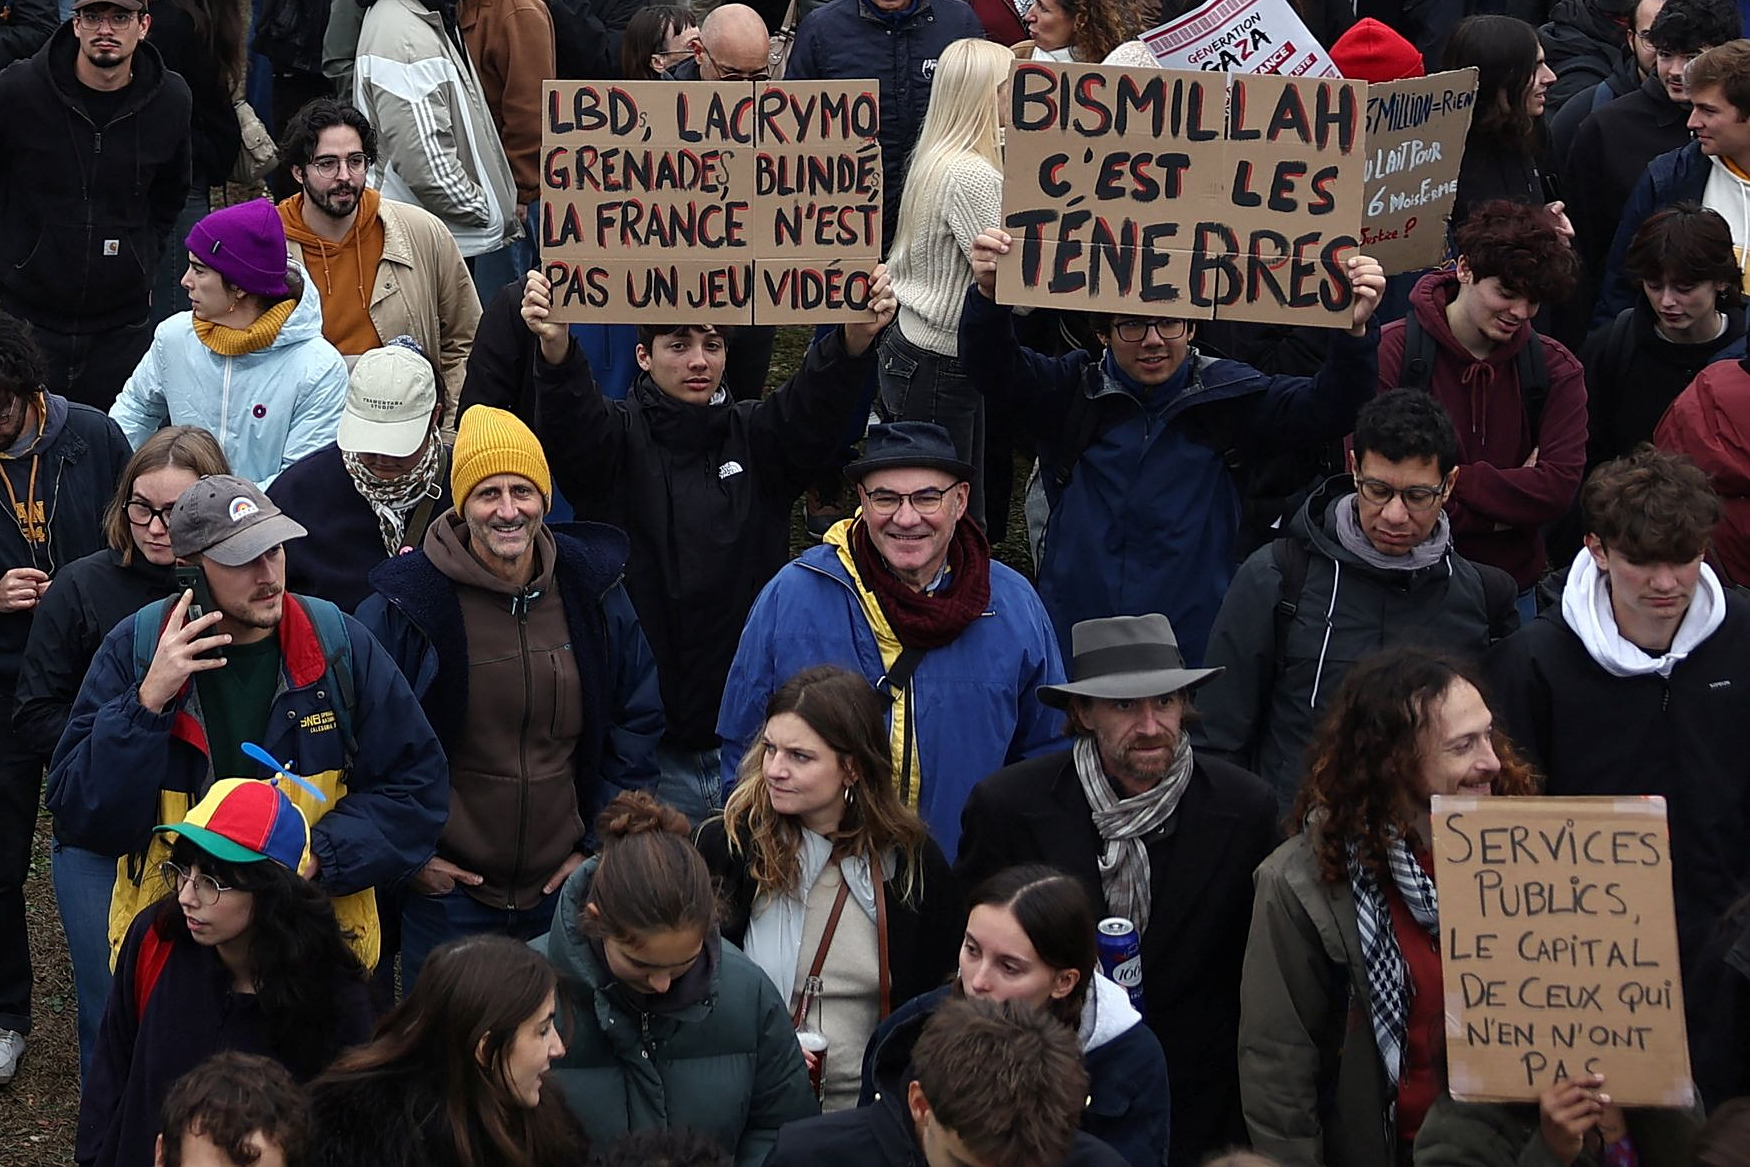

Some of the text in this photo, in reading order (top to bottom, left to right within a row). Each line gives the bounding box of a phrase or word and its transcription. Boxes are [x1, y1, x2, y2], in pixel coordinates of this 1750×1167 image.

[1188, 12, 1261, 64] GÉNÉRATION
[1200, 28, 1272, 73] GAZA
[677, 84, 880, 144] LACRYMO
[1011, 63, 1359, 156] BISMILLAH
[1038, 146, 1339, 216] C'EST LES
[1368, 186, 1387, 217] 6
[543, 197, 879, 249] LA FRANCE N'EST
[1403, 217, 1417, 238] ?
[1004, 195, 1360, 313] TÉNEBRES
[545, 258, 871, 311] PAS UN JEU VIDÉO
[1446, 813, 1661, 866] SERViCES
[1474, 869, 1640, 925] PUBLiCS,
[1450, 927, 1659, 968] LE CAPiTAL
[1460, 972, 1507, 1009] DE
[1518, 976, 1603, 1012] CEUX
[1467, 1017, 1653, 1051] N'EN N'ONT
[1520, 1051, 1601, 1086] PAS
